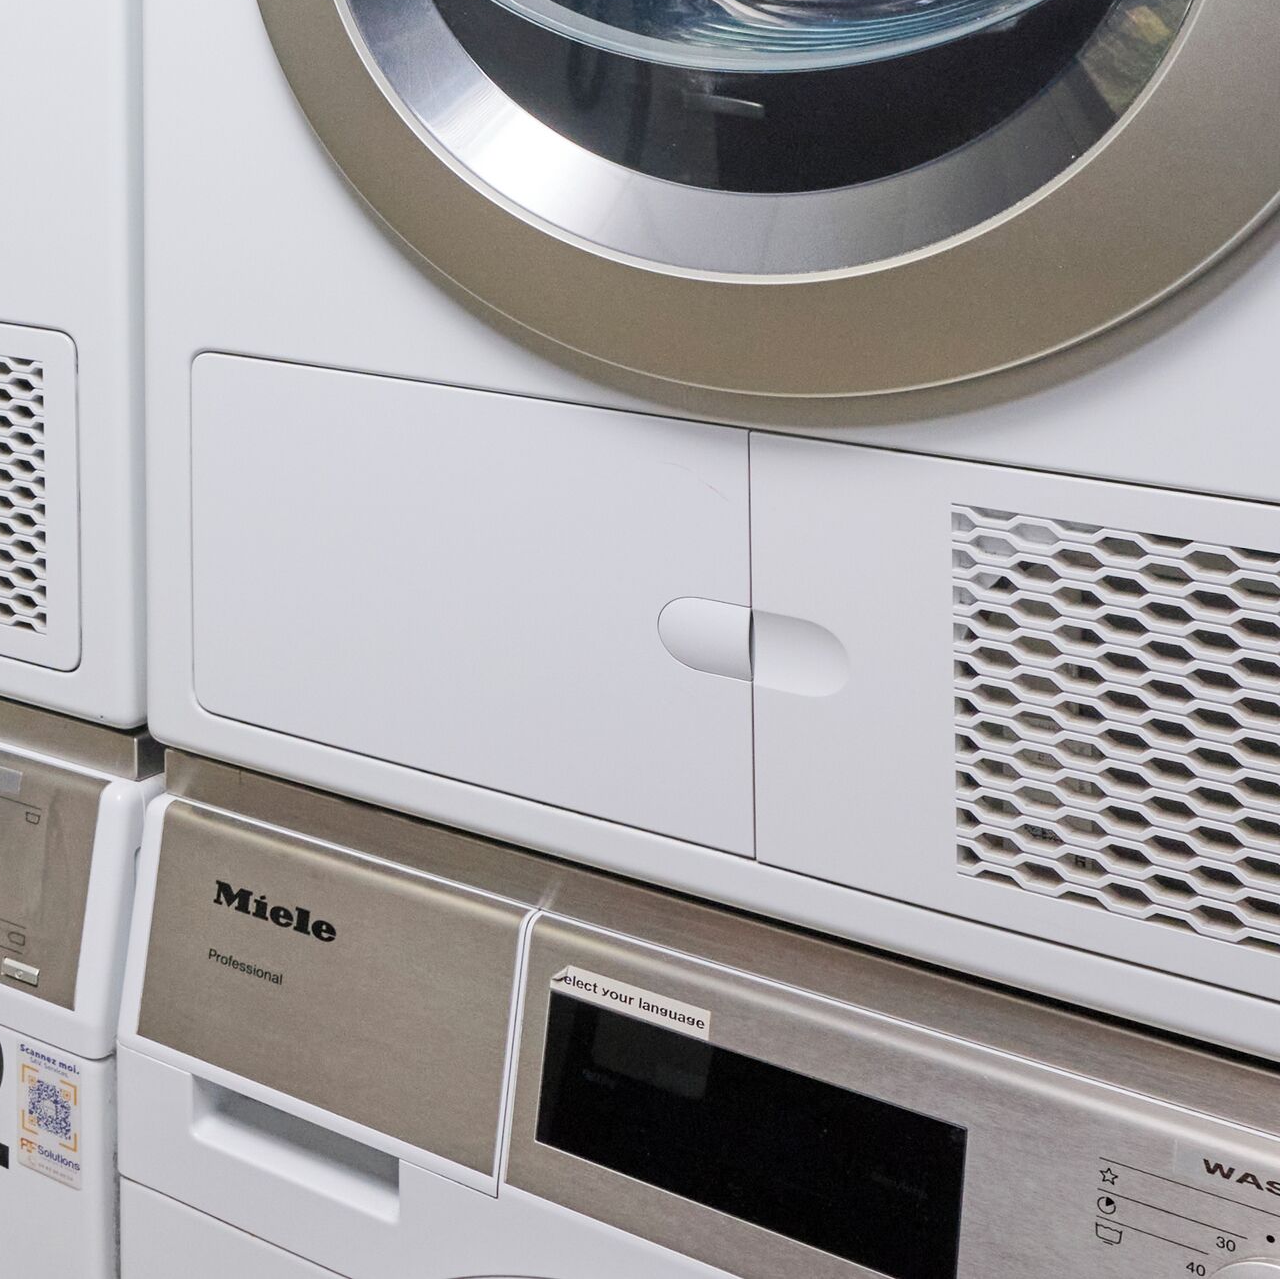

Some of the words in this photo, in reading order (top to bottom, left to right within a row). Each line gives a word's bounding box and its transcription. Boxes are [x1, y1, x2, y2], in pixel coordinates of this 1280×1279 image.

[213, 879, 337, 943] Miele
[208, 948, 283, 986] Professional
[553, 975, 598, 994] elect
[602, 987, 634, 1005] your
[638, 997, 705, 1029] language
[20, 1043, 56, 1066] Scannez
[37, 1144, 80, 1171] Solutions
[1215, 1236, 1236, 1252] 30
[1185, 1262, 1206, 1277] 40
